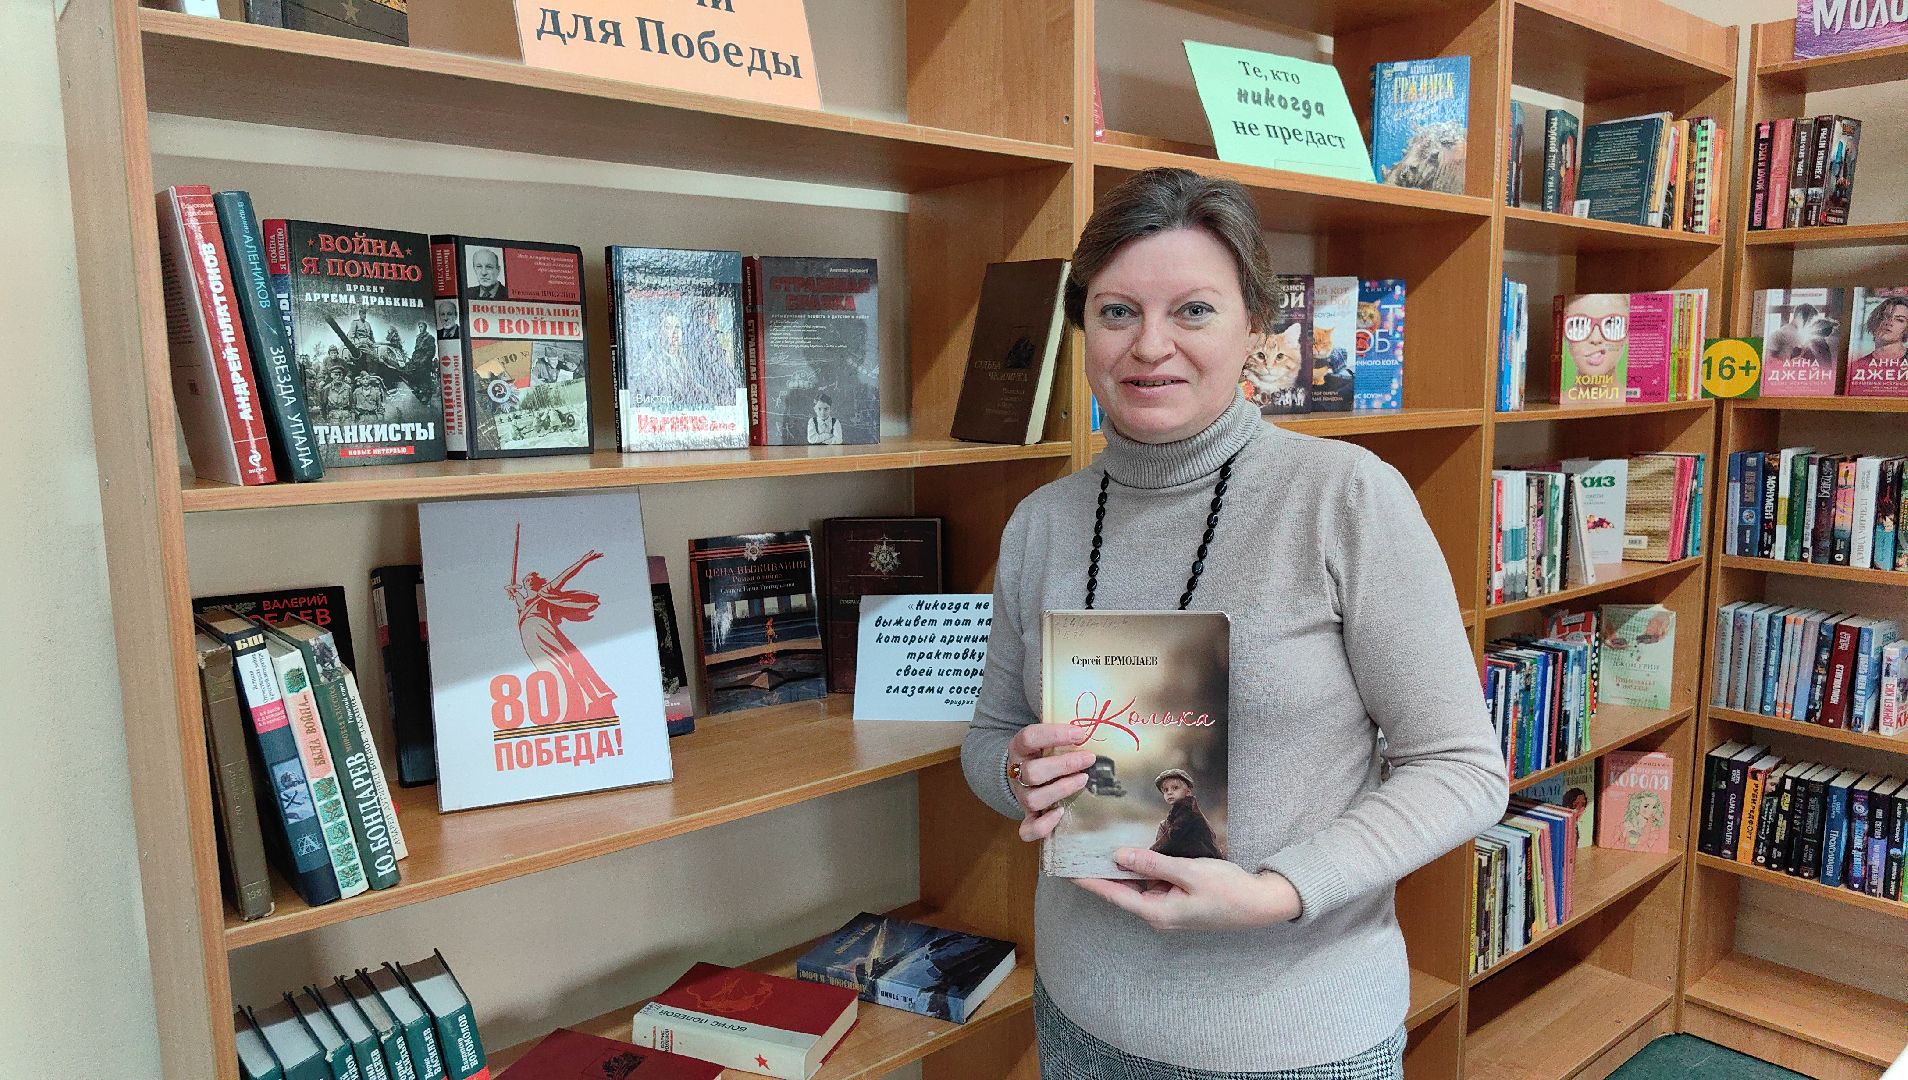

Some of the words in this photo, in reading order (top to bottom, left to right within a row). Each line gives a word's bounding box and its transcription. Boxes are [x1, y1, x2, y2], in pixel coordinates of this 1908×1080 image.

[537, 7, 625, 46] для
[635, 16, 803, 80] Победы
[1237, 59, 1267, 80] Те,
[1272, 70, 1301, 85] кто
[1237, 87, 1325, 120] никогда
[1232, 120, 1260, 137] не
[1266, 123, 1347, 150] предаст
[1818, 127, 1828, 148] ИГРЫ
[1814, 150, 1825, 179] УЗНИКИ
[318, 231, 405, 258] ВОЙНА
[301, 257, 321, 276] Я
[326, 258, 423, 282] ПОМНЮ
[201, 243, 236, 343] ПЛАТОНОВ
[345, 283, 385, 293] ПРОЕКТ
[305, 292, 356, 305] АРТЕМА
[361, 294, 424, 308] ДРАБКИНА
[471, 303, 579, 318] ВОСПОМИНАНИЯ
[473, 317, 489, 334] О
[498, 317, 581, 337] ВОЙНЕ
[243, 235, 271, 309] АЛЕНИКОВ
[269, 346, 297, 407] ЗВЕЗДА
[287, 413, 314, 470] УПАЛА
[747, 319, 757, 381] СТРАШНАЯ
[440, 355, 450, 367] О
[1381, 359, 1399, 367] КОТА
[1702, 355, 1757, 382] 16+
[1782, 357, 1820, 369] АННА
[1869, 357, 1908, 368] АННА
[222, 347, 254, 421] АНДРЕЙ
[1575, 374, 1615, 386] ХОЛЛИ
[1767, 367, 1833, 382] ДЖЕЙН
[1852, 368, 1908, 382] ДЖЕЙ
[1568, 385, 1620, 401] СМЕЙЛ
[441, 372, 456, 436] ВОЙНЕ
[749, 383, 760, 427] СКАЗКА
[313, 421, 435, 445] ТАНКИСТЫ
[373, 446, 407, 456] ИНТЕРВЬЮ
[1765, 475, 1777, 521] МОНУМЕНТ
[705, 566, 735, 578] ЦЕНА
[736, 560, 807, 575] ВЫЖИВАНИЯ
[262, 593, 328, 611] ВАЛЕРИЙ
[907, 599, 970, 614] «Никогда
[974, 601, 991, 611] не
[874, 614, 938, 628] выживет
[942, 617, 973, 627] тот
[976, 617, 992, 627] на
[875, 632, 937, 646] который
[939, 633, 988, 647] приним
[906, 647, 985, 663] трактовку
[1071, 655, 1102, 668] Сергей
[1104, 655, 1158, 666] ЕРМОЛАЕВ
[895, 664, 933, 677] своей
[937, 666, 985, 680] истори
[489, 670, 561, 729] 80
[885, 685, 944, 698] глазами
[1884, 682, 1895, 700] КИЗ
[944, 698, 974, 708] Фридрих
[1069, 691, 1216, 752] Колька
[1882, 700, 1894, 728] ДЭНИЕЛ
[309, 739, 326, 767] БЫЛА
[494, 727, 624, 772] ПОБЕДА!
[1729, 793, 1737, 814] ОДНА
[1750, 782, 1759, 804] РУБИ
[1746, 805, 1757, 841] РЕДФОРТ
[657, 1008, 708, 1024] ПОЛЕВОЙ
[710, 1019, 748, 1032] БОРИС
[423, 1028, 442, 1075] ВАСИЛЬЕВ
[457, 1014, 479, 1068] БОГОМОЛОВ
